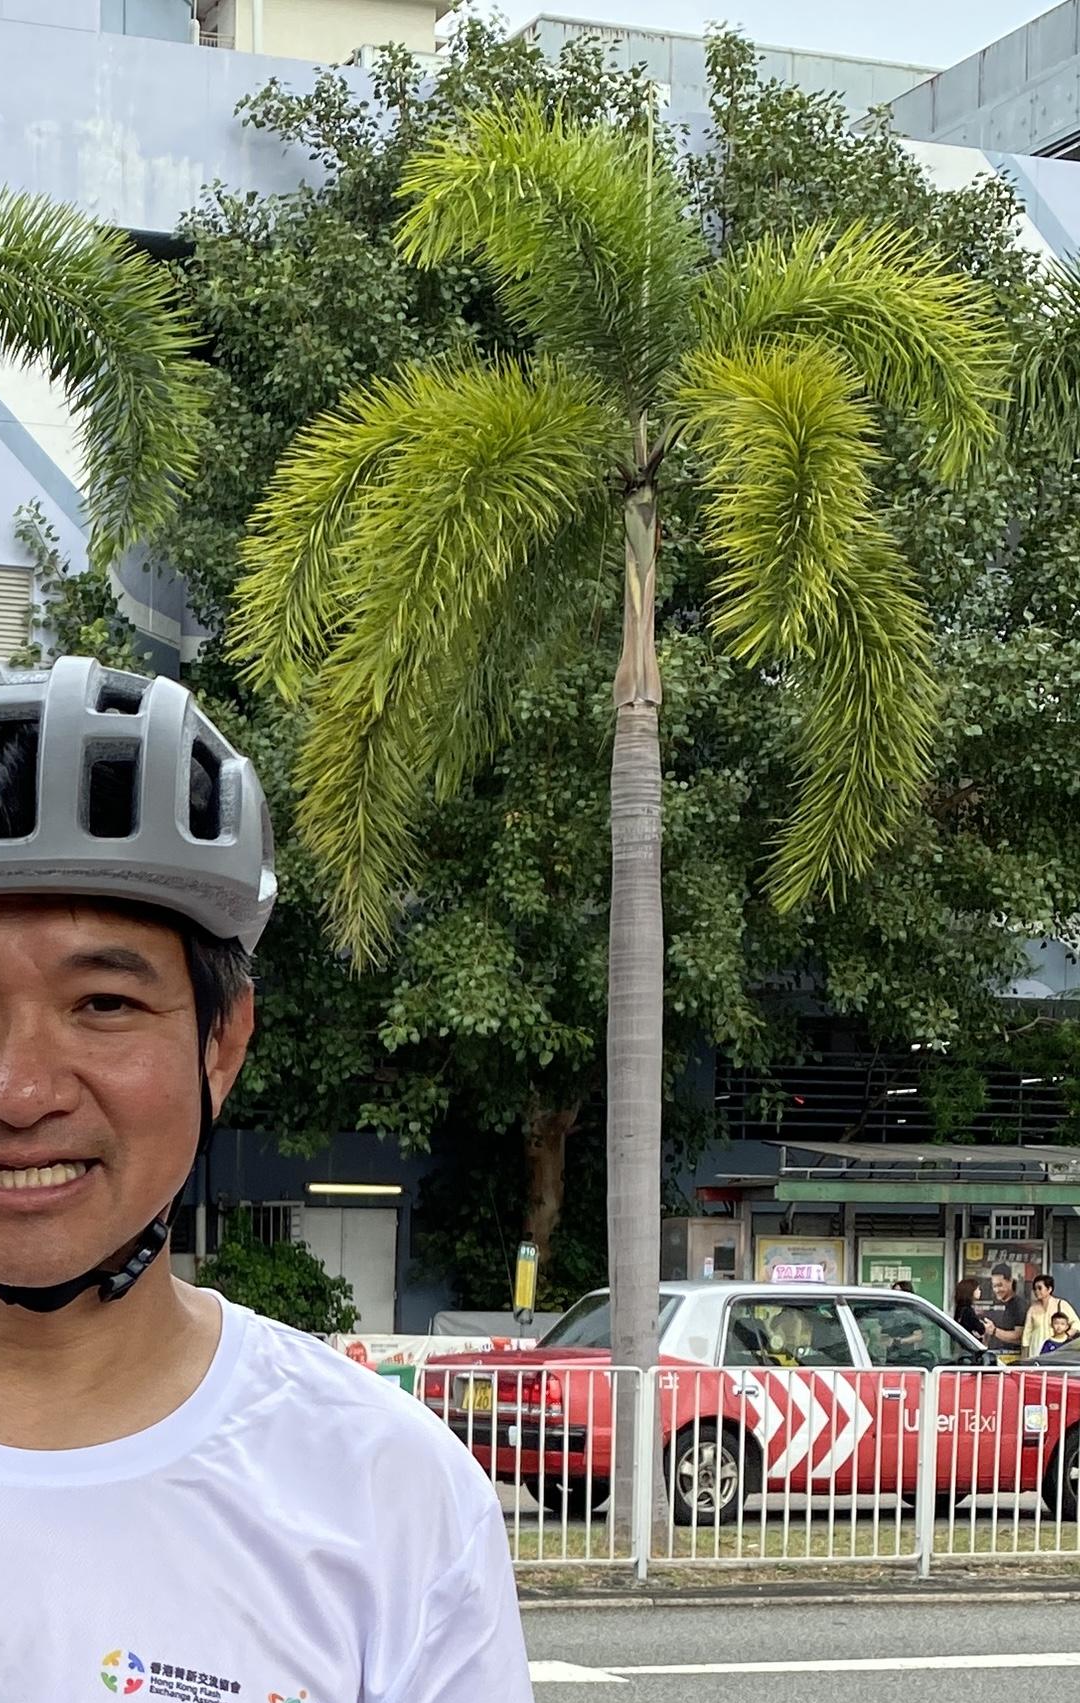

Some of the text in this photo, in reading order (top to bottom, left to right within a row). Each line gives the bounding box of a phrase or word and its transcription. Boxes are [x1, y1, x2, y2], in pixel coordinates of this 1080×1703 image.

[903, 1408, 998, 1432] Uer Taxi
[149, 1684, 192, 1702] Exchange
[150, 1676, 174, 1690] Hong
[176, 1681, 198, 1696] Kong
